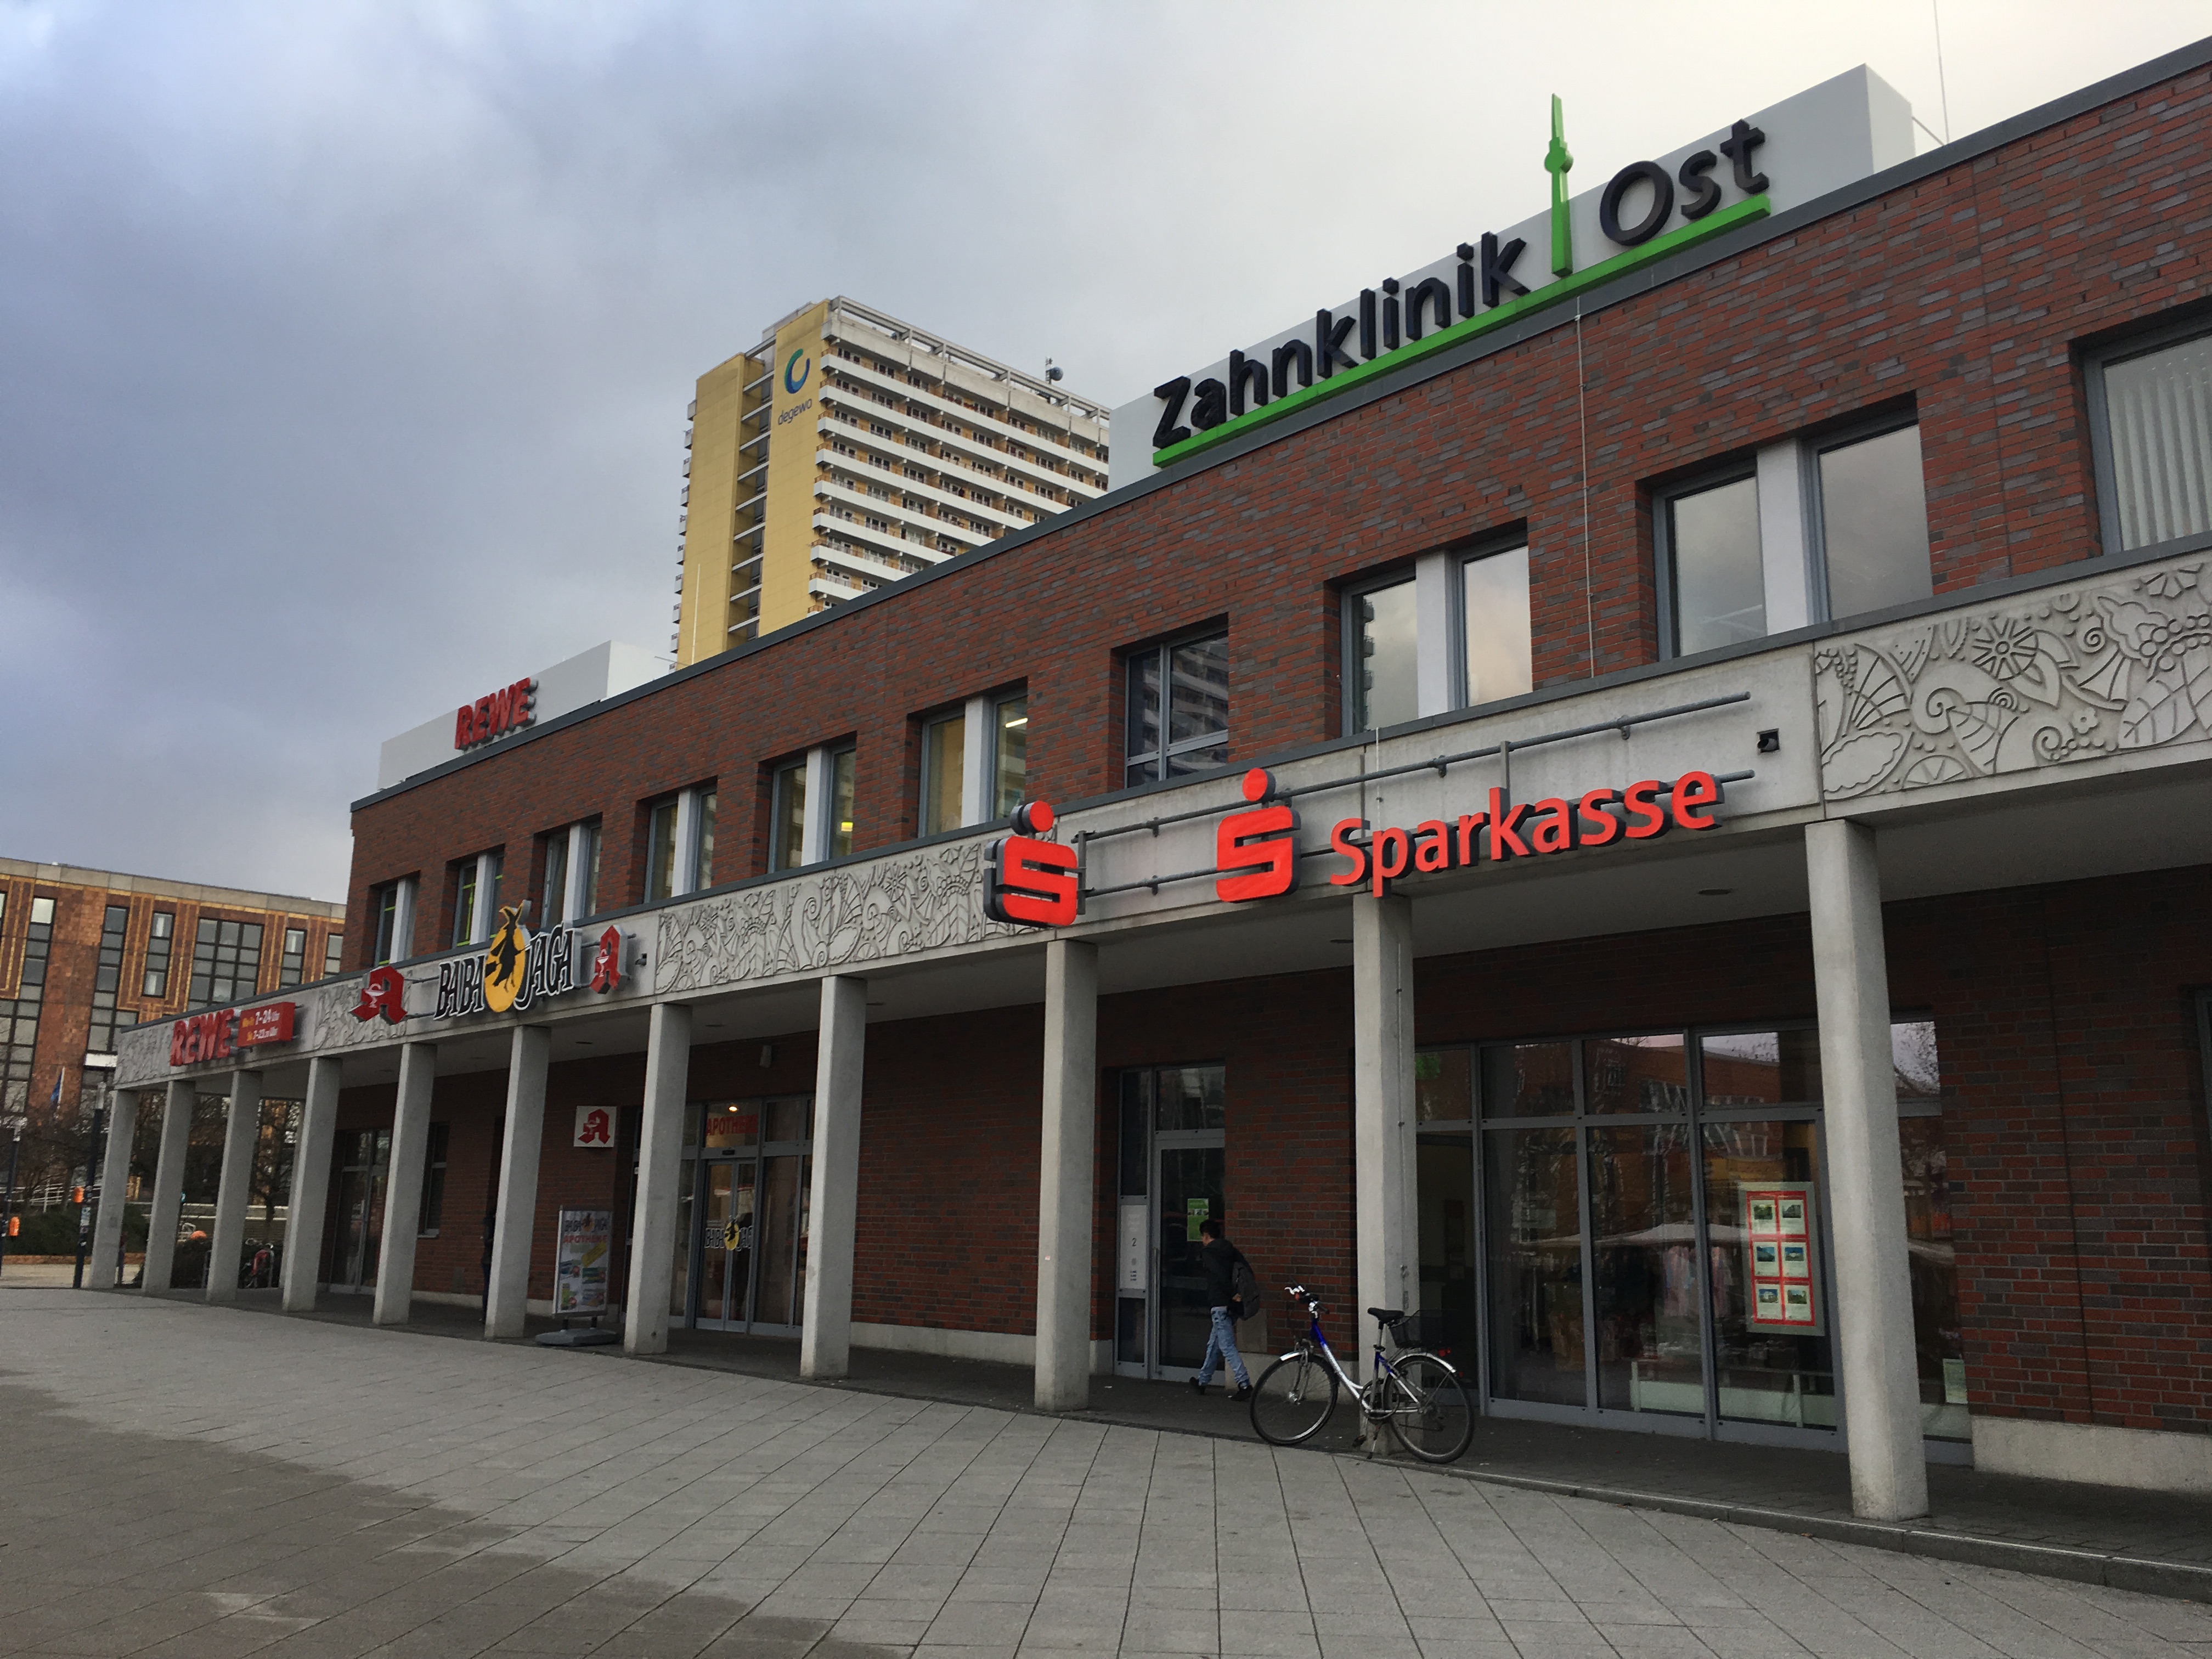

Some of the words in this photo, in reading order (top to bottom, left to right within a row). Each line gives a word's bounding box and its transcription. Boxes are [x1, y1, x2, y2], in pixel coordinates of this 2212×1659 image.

[1153, 231, 1531, 450] Zahnklinik
[1600, 119, 1770, 246] Ost
[778, 398, 812, 425] degewo
[455, 677, 531, 750] REWE
[1330, 770, 1724, 898] Sparkasse
[433, 955, 487, 1021] BABA
[514, 923, 575, 1011] JAGA
[170, 1008, 234, 1066] REWE
